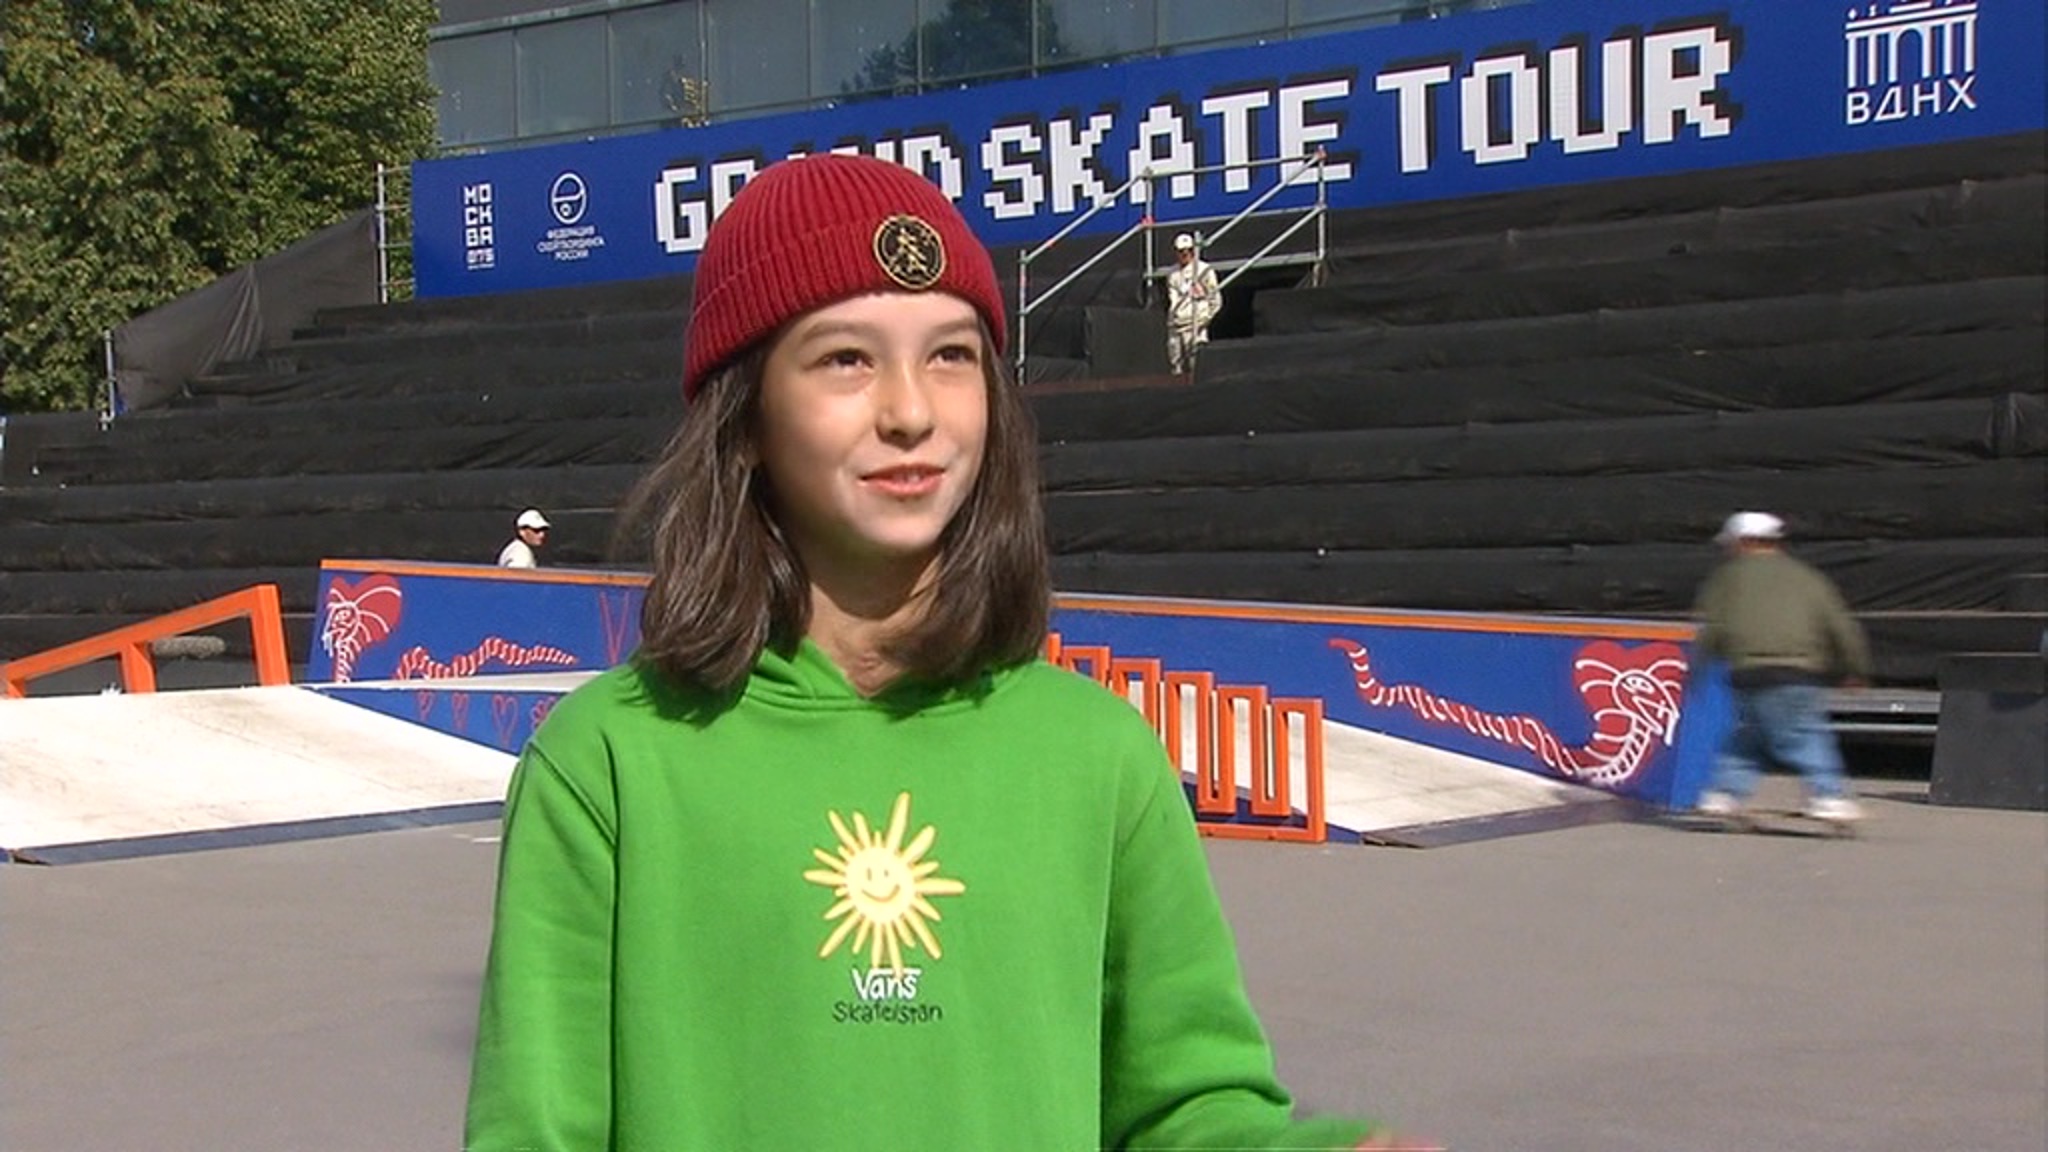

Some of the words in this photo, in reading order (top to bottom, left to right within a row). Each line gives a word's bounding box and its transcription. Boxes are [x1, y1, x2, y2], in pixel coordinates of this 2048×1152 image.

[981, 80, 1352, 219] SKATE
[1376, 26, 1730, 173] TOUR
[1846, 76, 1977, 125] ВДНХ
[851, 967, 922, 1000] Vans
